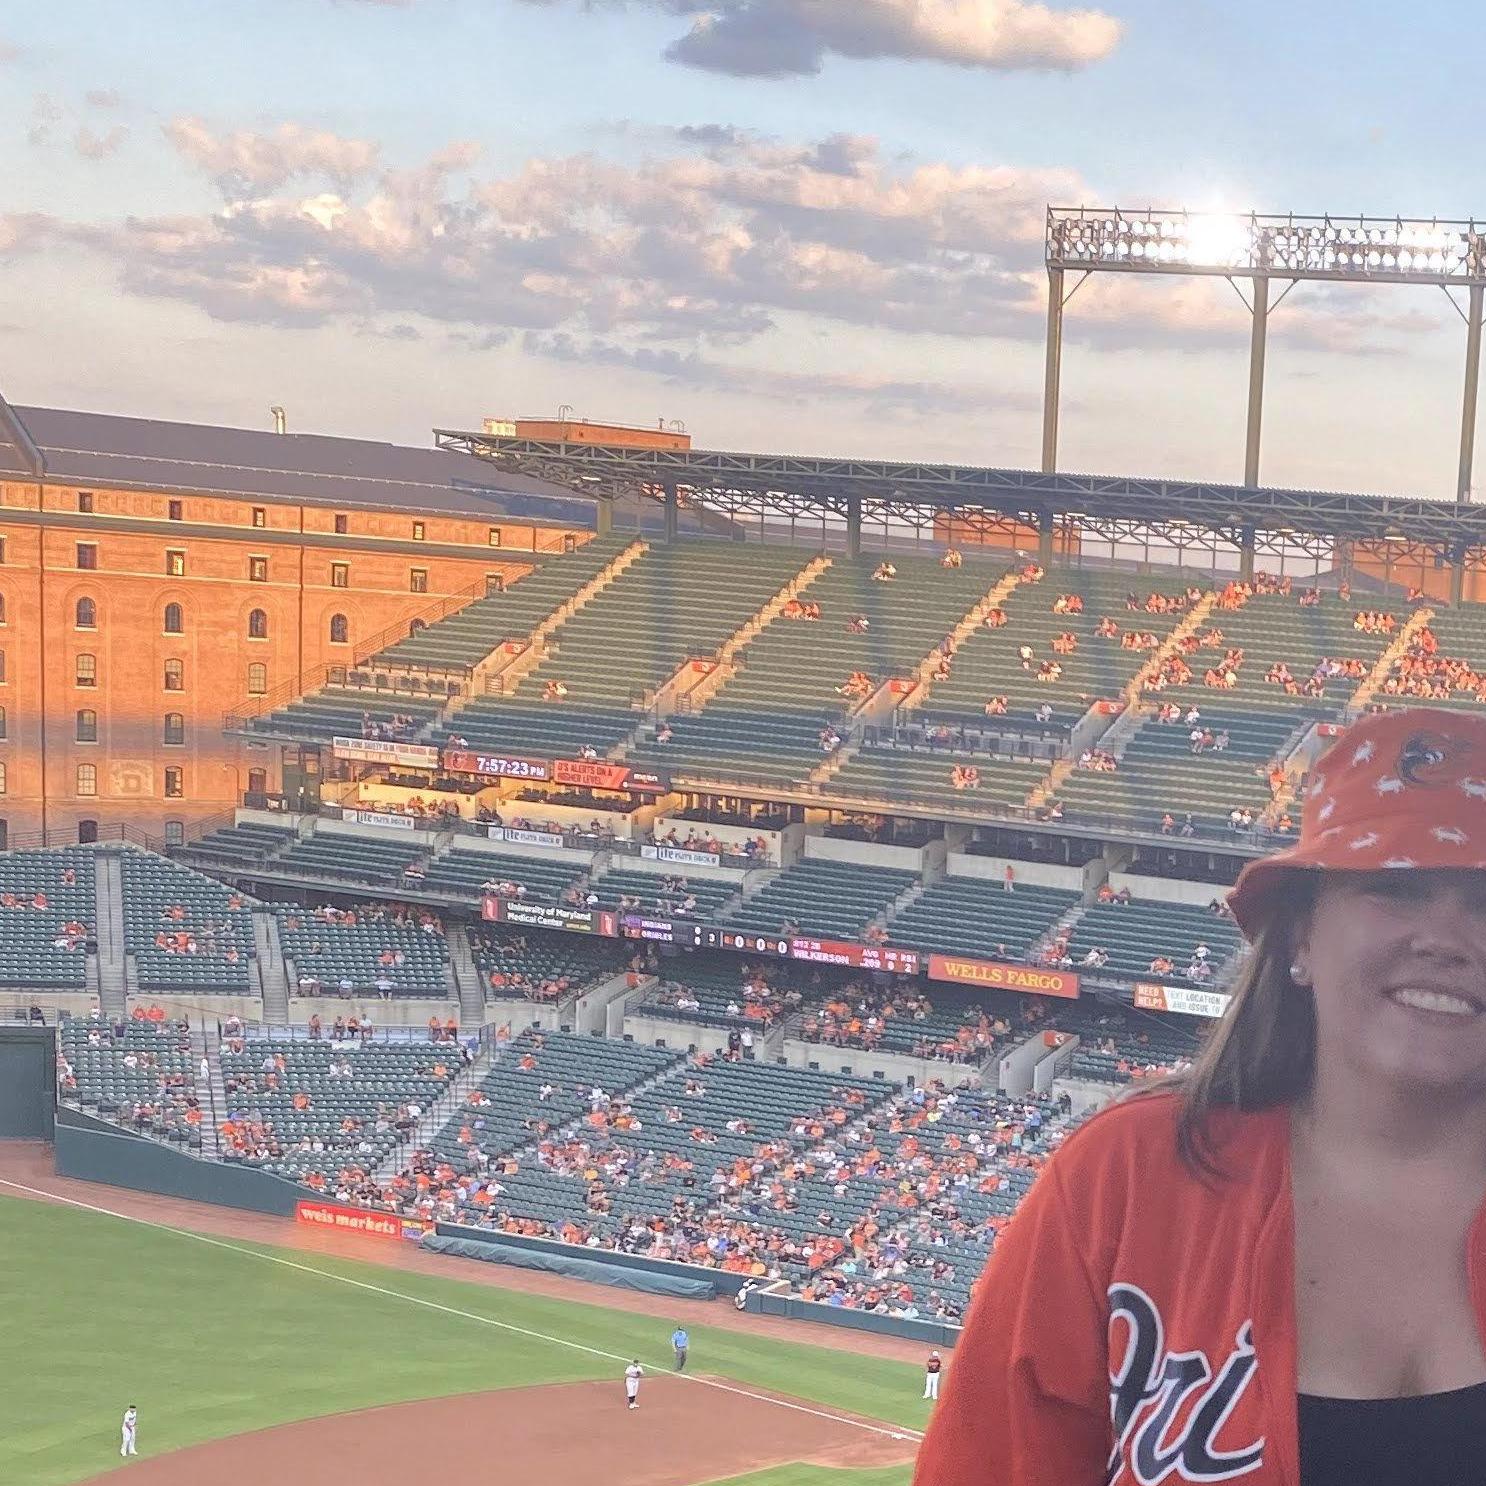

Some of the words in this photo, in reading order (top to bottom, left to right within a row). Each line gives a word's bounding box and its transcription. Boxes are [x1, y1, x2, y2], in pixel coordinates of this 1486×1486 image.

[477, 757, 528, 776] 7:57:23
[530, 767, 545, 777] PM
[507, 902, 545, 915] University
[546, 907, 555, 916] of
[556, 908, 592, 921] Maryland
[507, 912, 536, 923] Medical
[537, 915, 563, 927] Center
[735, 936, 744, 948] 0
[757, 939, 766, 951] 0
[778, 941, 787, 953] 0
[944, 961, 1002, 982] WELLS
[1005, 970, 1063, 991] FARGO
[1139, 985, 1160, 996] NEED
[1186, 994, 1221, 1005] LOCATION
[1188, 1003, 1209, 1013] ISSUE
[300, 1208, 335, 1224] weis
[335, 1214, 397, 1234] markets
